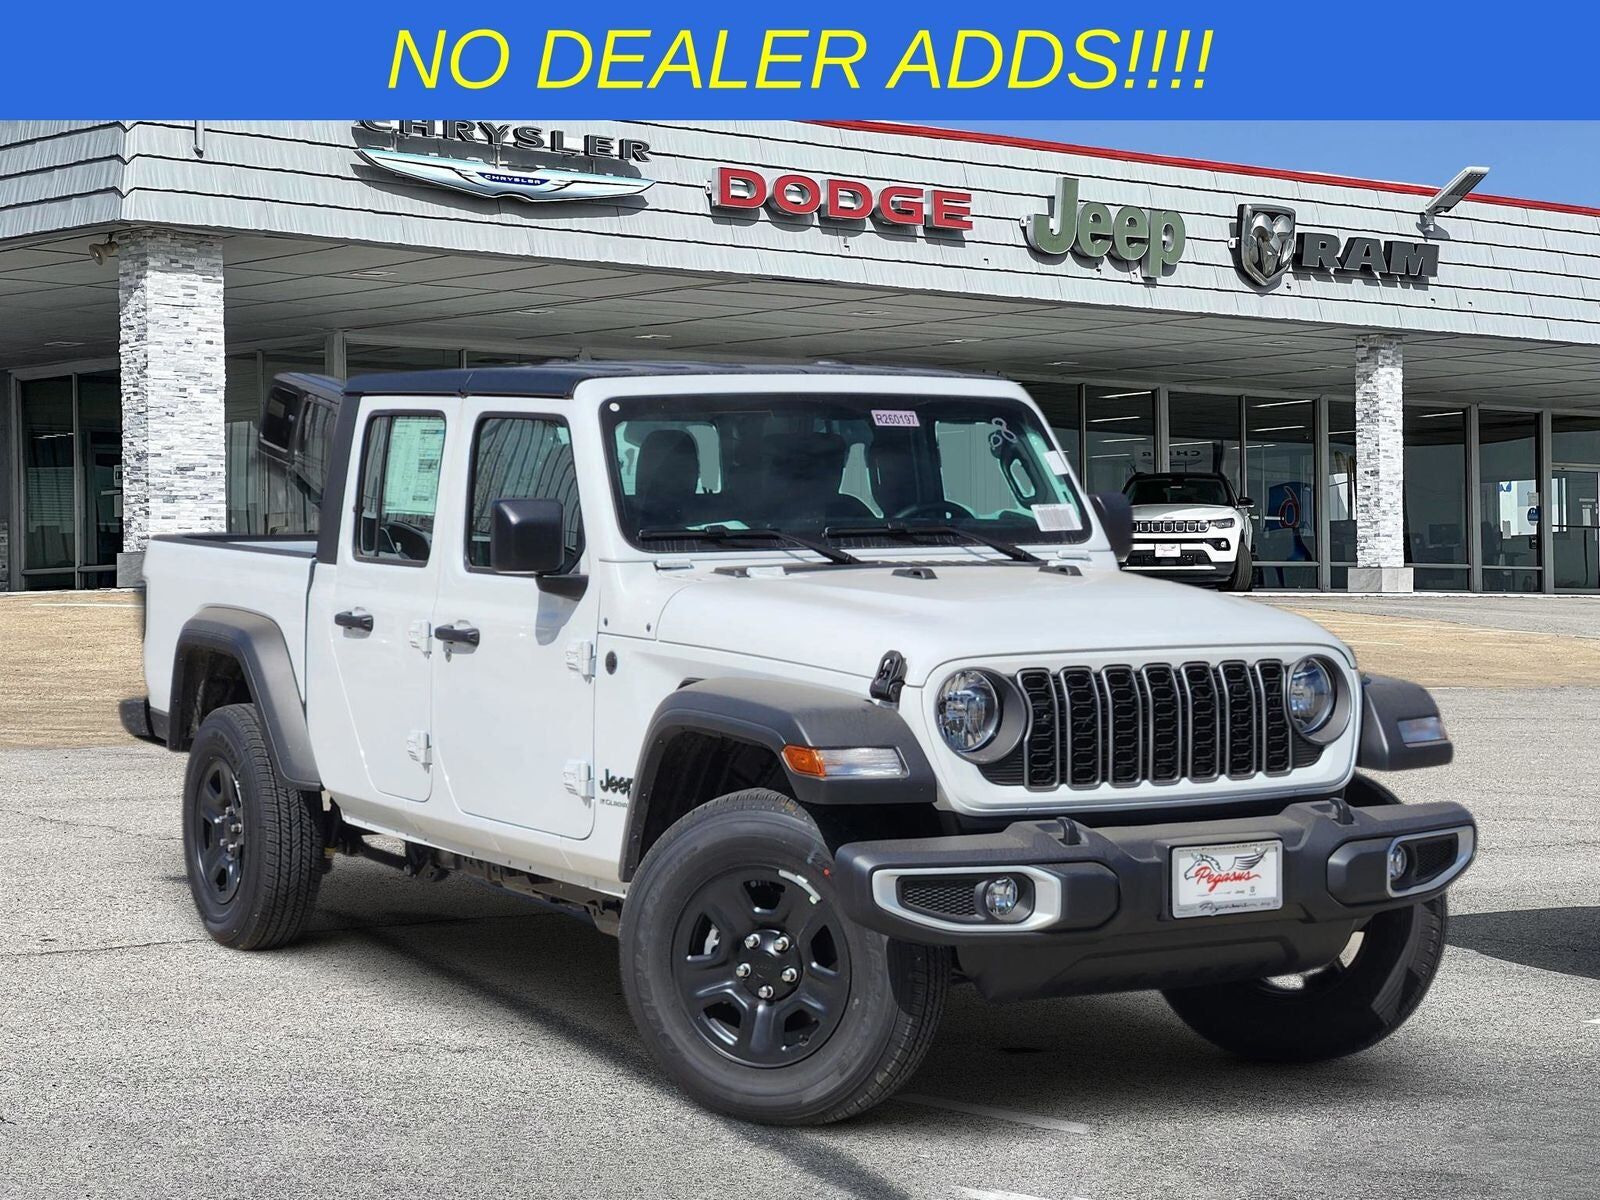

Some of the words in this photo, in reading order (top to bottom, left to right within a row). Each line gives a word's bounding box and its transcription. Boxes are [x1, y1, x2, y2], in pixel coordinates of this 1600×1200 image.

[483, 173, 542, 186] CHRYSLER
[714, 167, 973, 231] DODGE
[1026, 176, 1186, 279] Jeep
[1296, 232, 1440, 278] RAM
[875, 413, 916, 425] R260197
[1195, 865, 1261, 892] Pegasus
